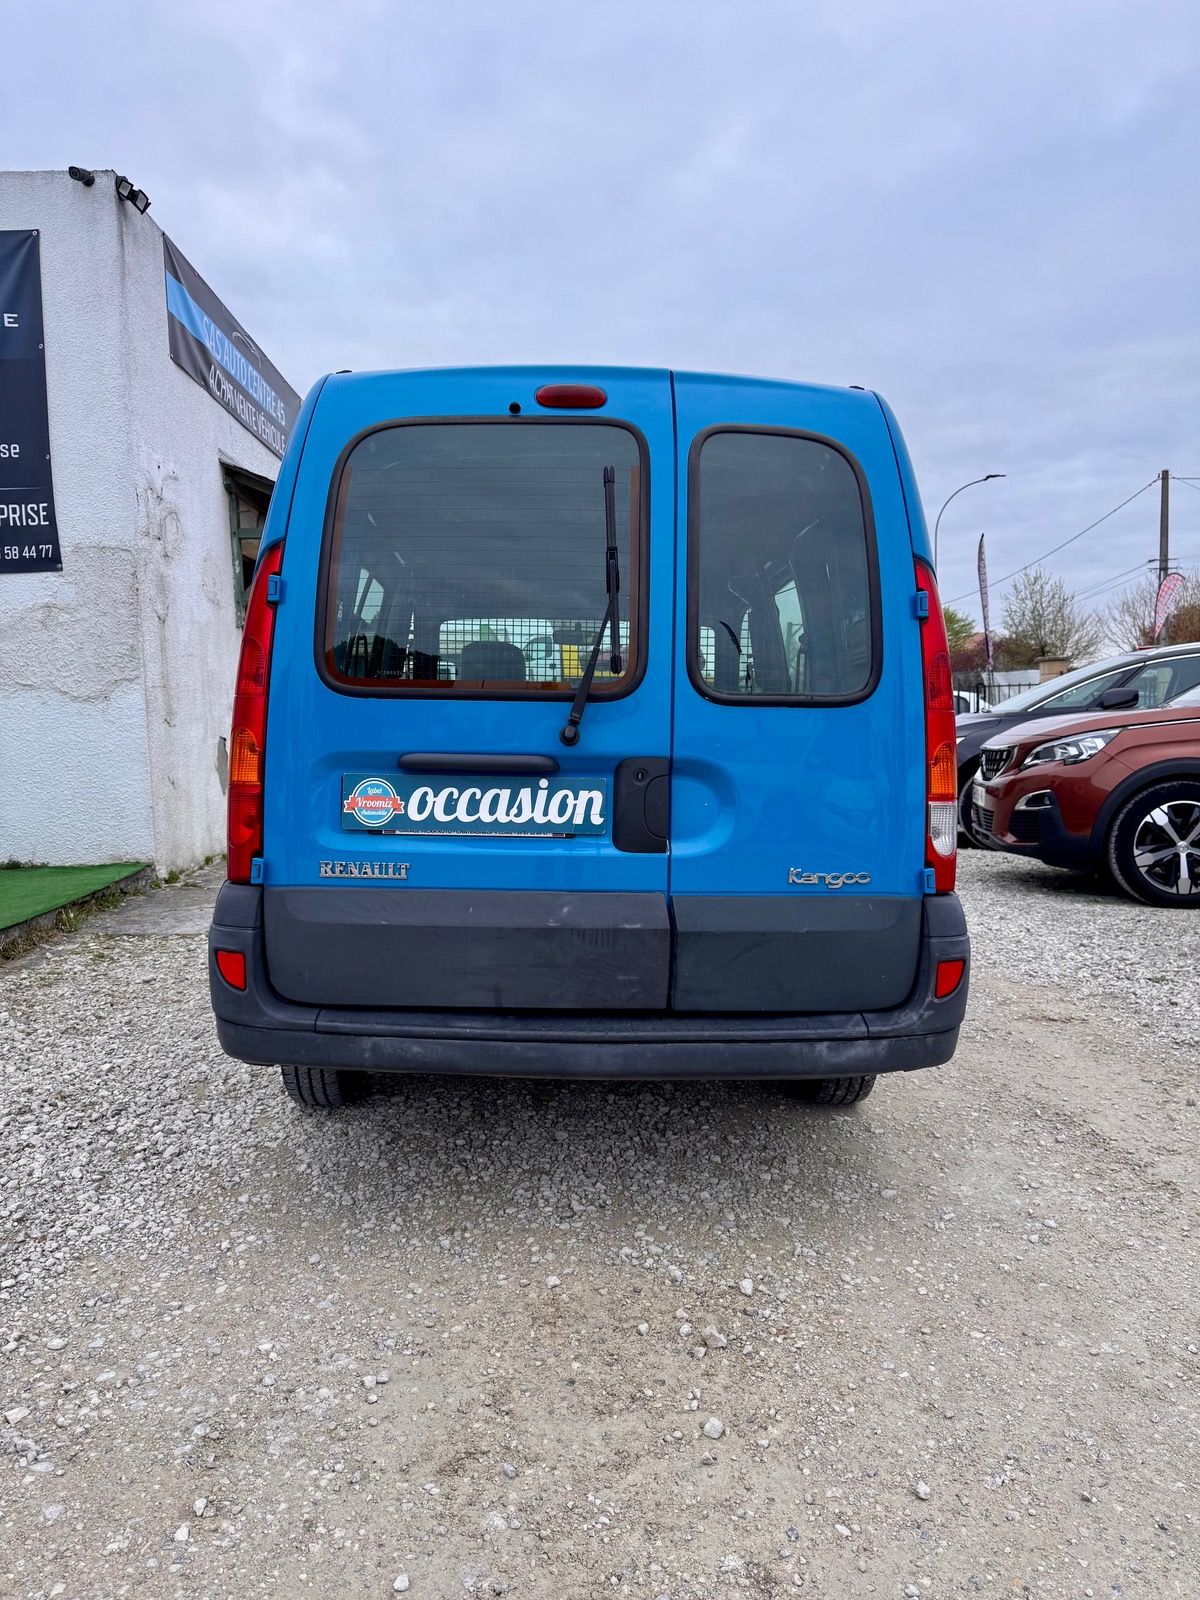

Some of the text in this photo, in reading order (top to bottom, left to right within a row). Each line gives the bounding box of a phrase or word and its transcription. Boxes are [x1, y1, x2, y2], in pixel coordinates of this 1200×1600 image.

[3, 313, 19, 328] E
[203, 315, 286, 426] SAS AUTO CENTRE 45
[209, 364, 235, 409] ACHAT
[233, 388, 258, 431] VENTE
[0, 444, 20, 458] se
[0, 502, 50, 526] PRISE
[4, 545, 19, 560] 58
[22, 545, 37, 559] 44
[39, 544, 53, 558] 77
[366, 787, 383, 796] Label
[356, 797, 393, 808] Vroomiz
[407, 778, 605, 826] occasion
[319, 860, 410, 880] RENAULT
[788, 867, 871, 889] Kangoo
